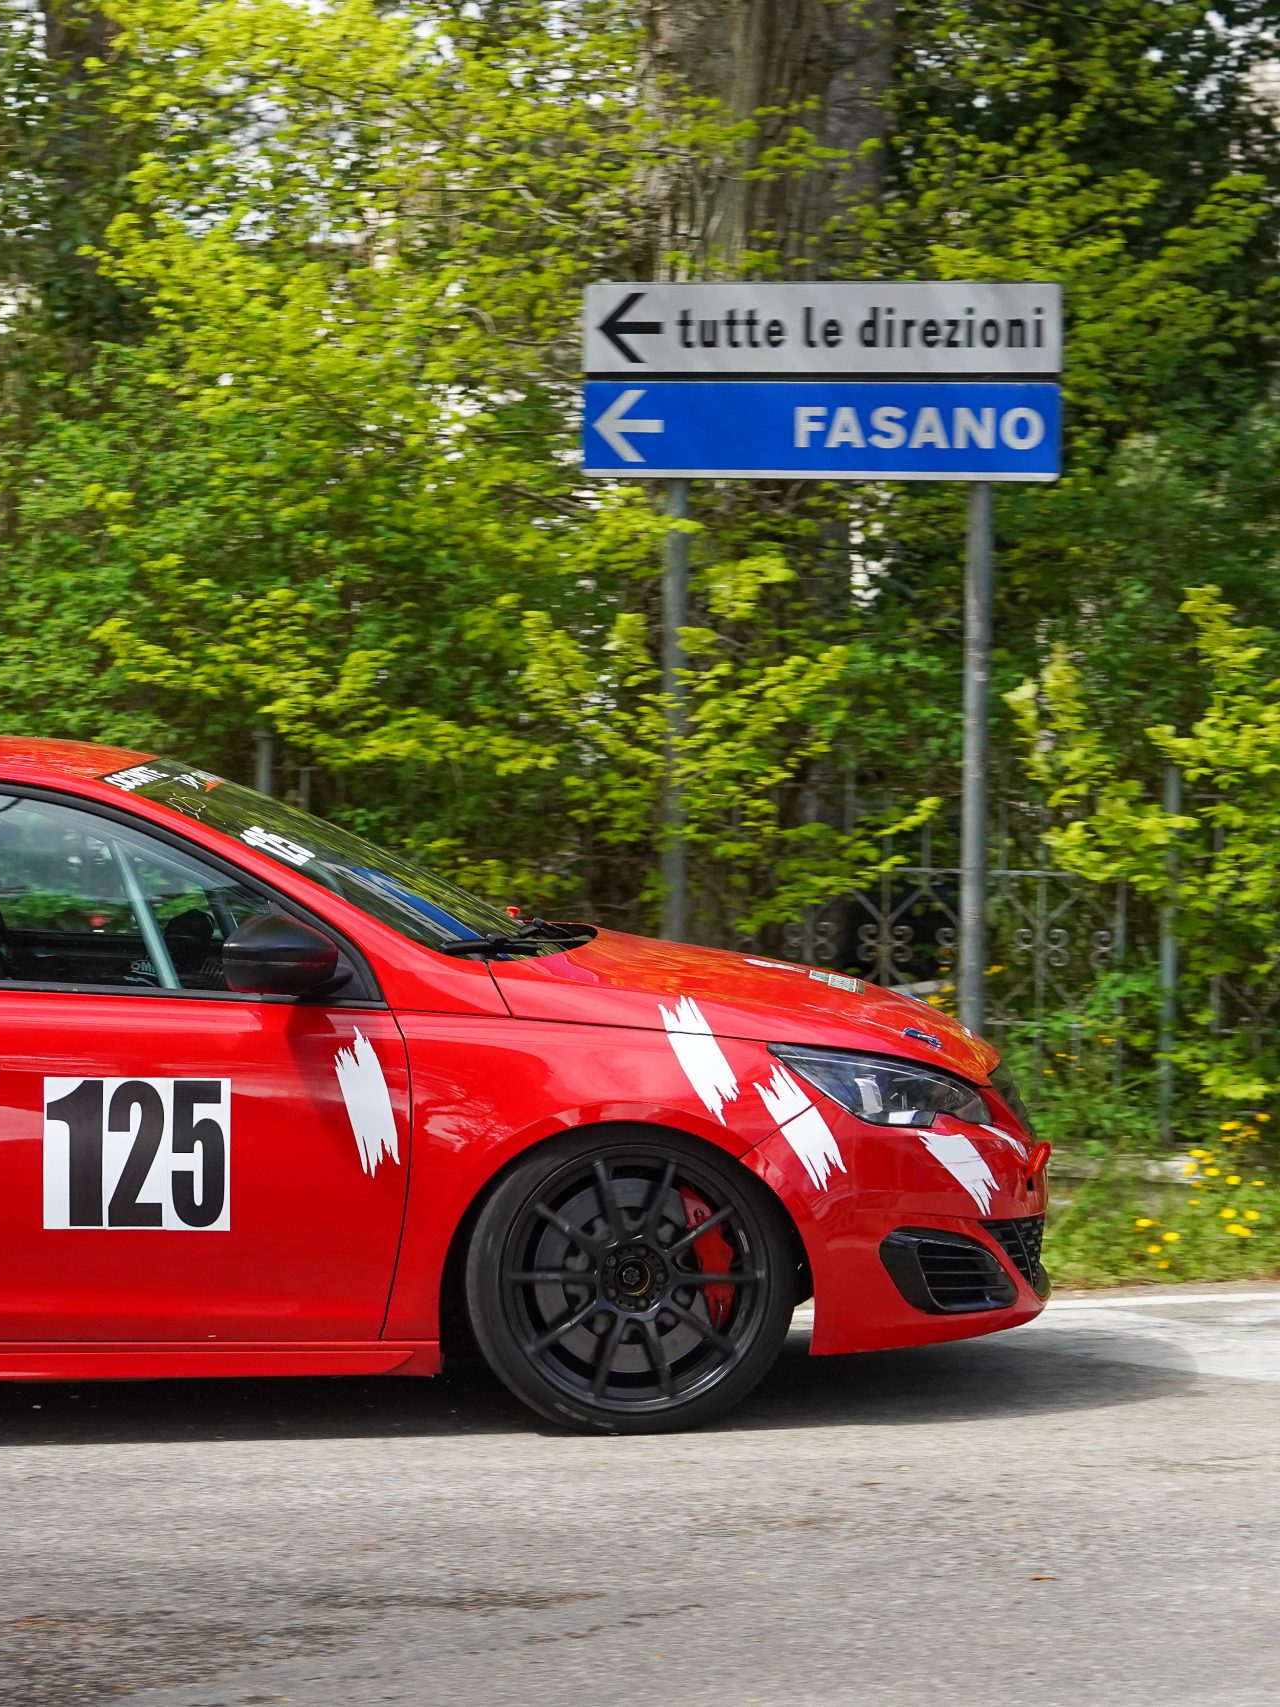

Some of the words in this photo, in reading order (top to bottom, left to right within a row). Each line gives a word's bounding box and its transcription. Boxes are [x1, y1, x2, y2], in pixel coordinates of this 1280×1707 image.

[677, 308, 786, 348] tutte
[803, 307, 843, 348] le
[858, 308, 1045, 348] direzioni
[794, 406, 1044, 450] FASANO
[239, 825, 316, 867] 125
[47, 1080, 226, 1228] 125
